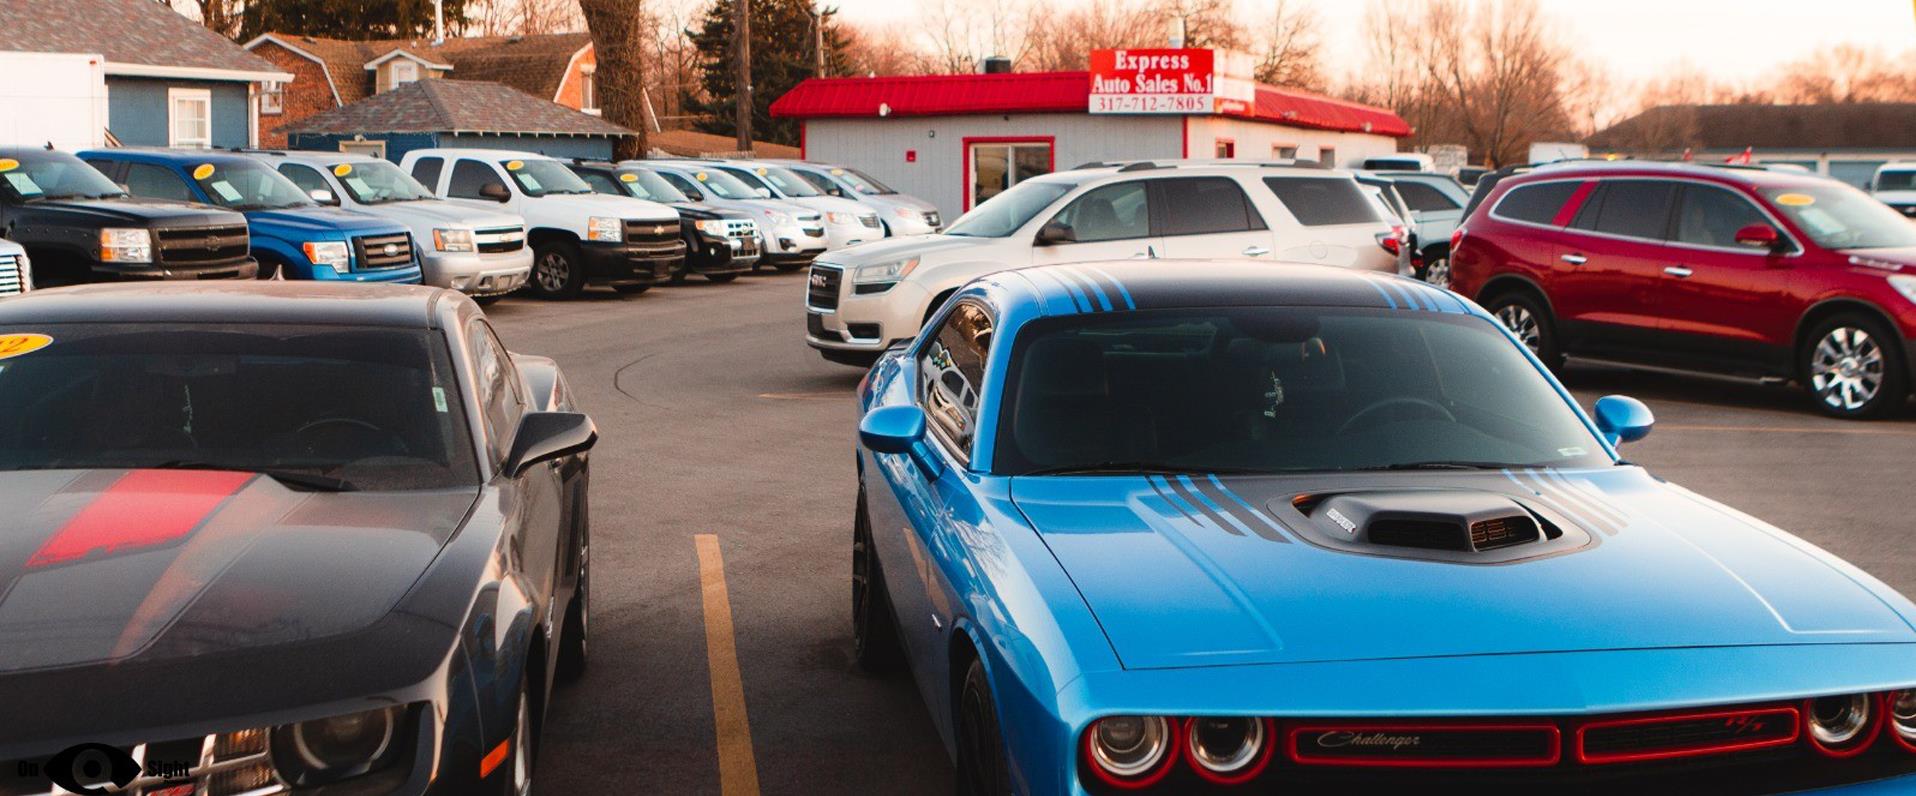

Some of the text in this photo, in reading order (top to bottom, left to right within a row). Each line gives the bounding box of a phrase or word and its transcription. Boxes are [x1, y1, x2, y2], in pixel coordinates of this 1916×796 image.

[1114, 51, 1190, 73] Express
[1092, 73, 1213, 93] Auto Sales No.1
[1099, 97, 1205, 111] 317-712-7805
[1317, 731, 1421, 750] Challenger
